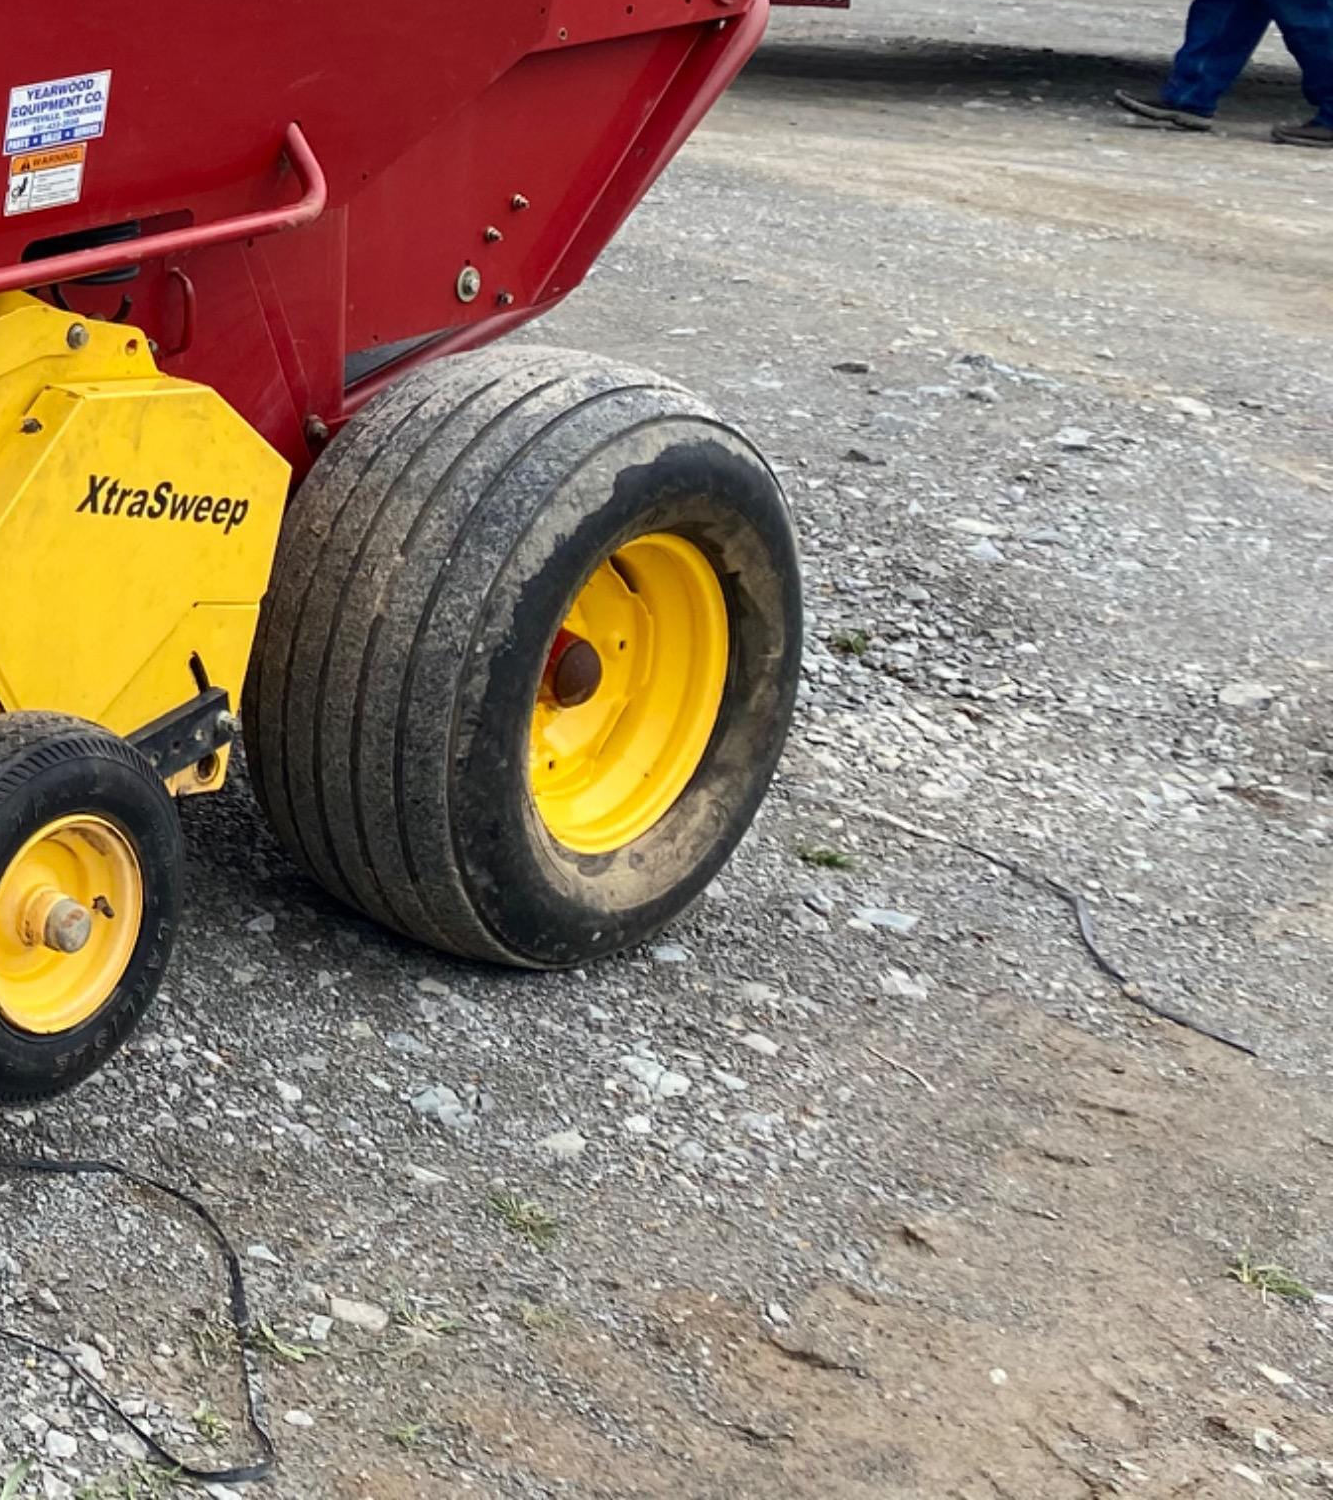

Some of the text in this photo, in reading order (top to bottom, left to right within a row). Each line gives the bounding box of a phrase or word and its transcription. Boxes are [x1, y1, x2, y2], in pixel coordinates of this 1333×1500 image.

[27, 78, 95, 101] YEARWOOD
[11, 94, 82, 118] EQUIPMENT
[33, 149, 79, 167] WARNING
[75, 474, 249, 535] XtraSweep
